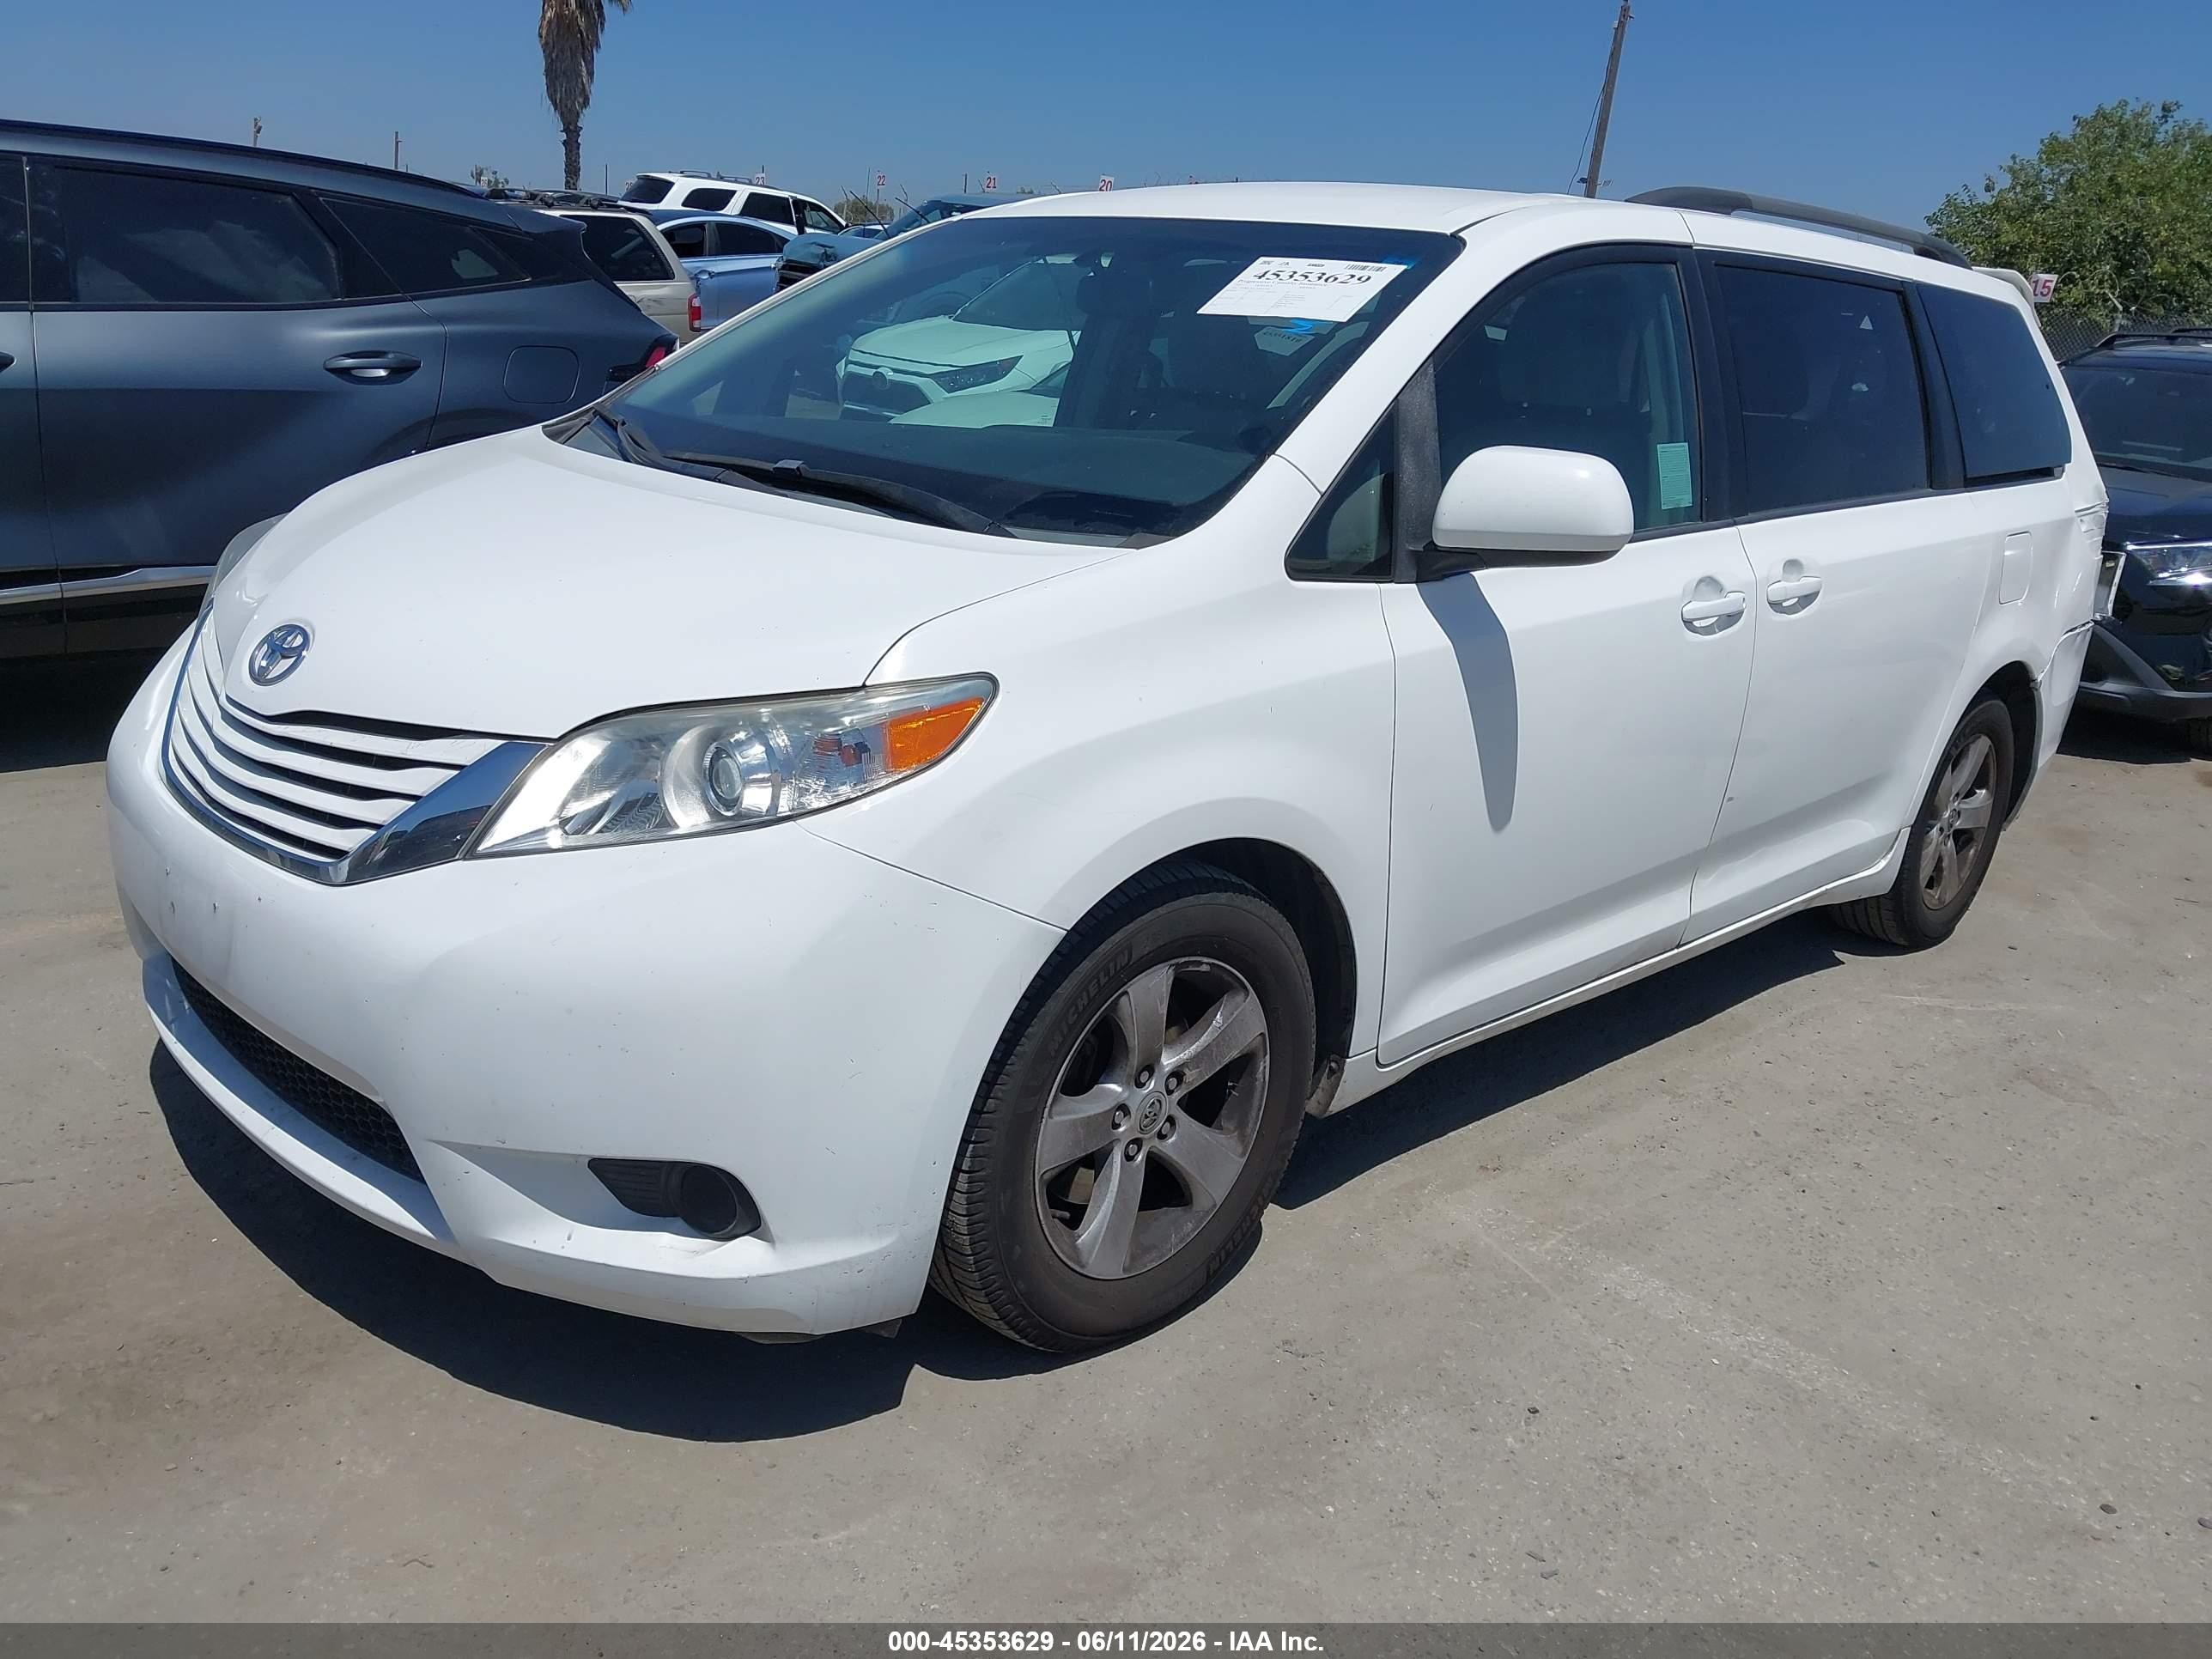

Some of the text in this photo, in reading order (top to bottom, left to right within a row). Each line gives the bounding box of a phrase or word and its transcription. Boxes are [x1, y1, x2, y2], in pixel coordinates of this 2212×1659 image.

[877, 175, 885, 185] 22
[986, 177, 996, 188] 21
[1099, 179, 1113, 191] 20
[1253, 270, 1372, 285] 45353629
[2033, 278, 2054, 297] 15
